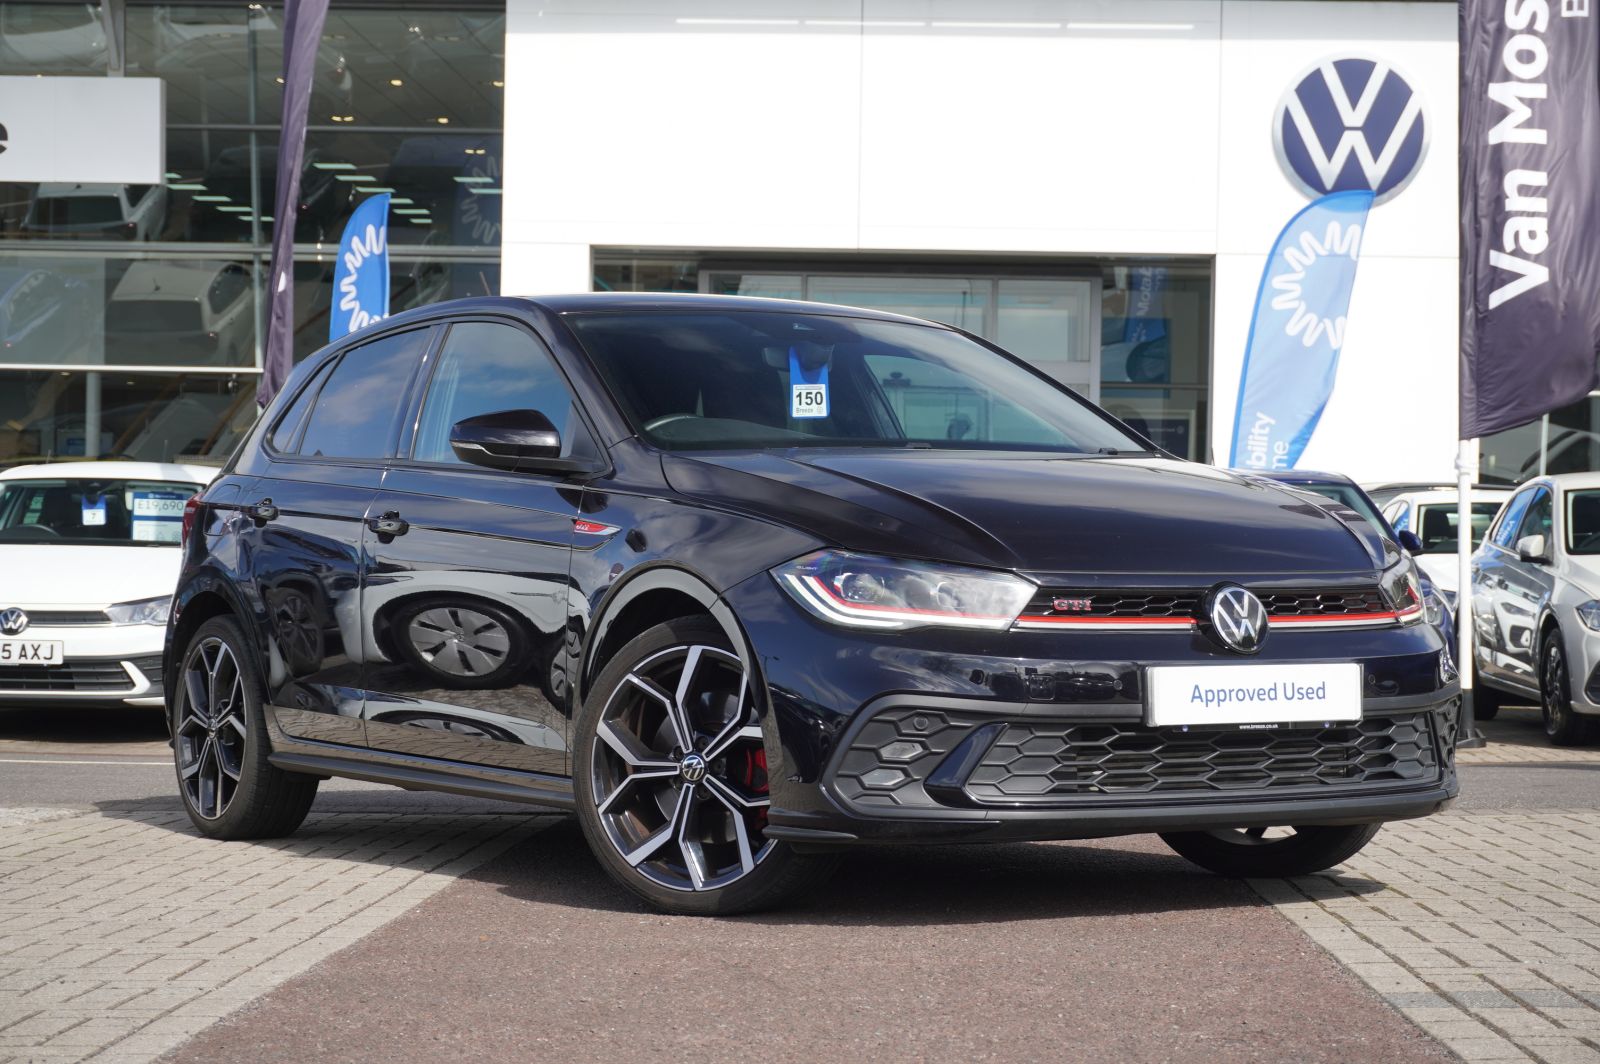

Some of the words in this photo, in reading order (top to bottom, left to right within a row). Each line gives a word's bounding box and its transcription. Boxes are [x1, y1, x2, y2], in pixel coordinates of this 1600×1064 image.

[1488, 0, 1550, 146] Mos
[1278, 57, 1428, 196] VW
[1489, 168, 1550, 310] Van
[796, 391, 824, 406] 150
[1246, 412, 1277, 469] bility
[1053, 598, 1092, 611] GTI
[18, 643, 54, 660] AXJ
[1190, 682, 1278, 708] Approved
[1283, 681, 1326, 701] Used
